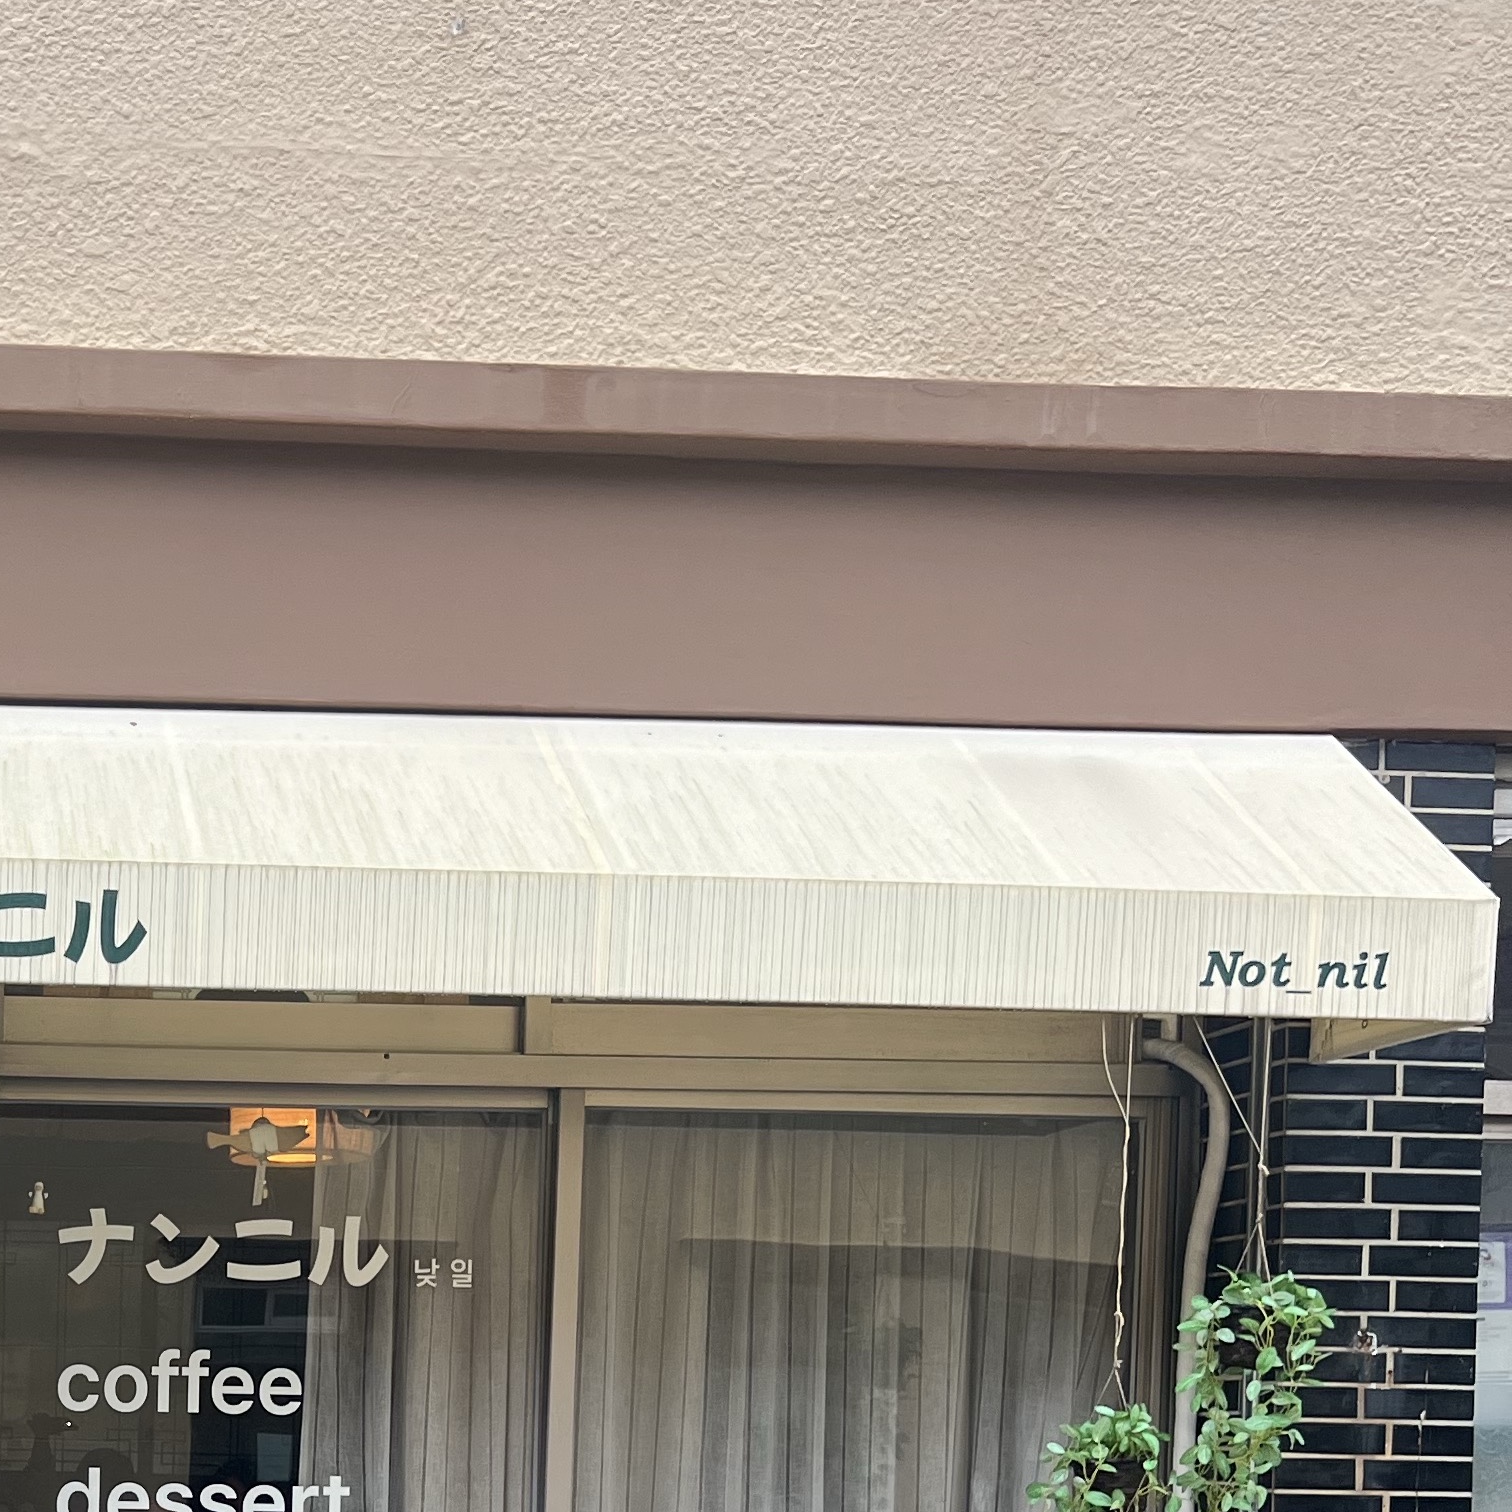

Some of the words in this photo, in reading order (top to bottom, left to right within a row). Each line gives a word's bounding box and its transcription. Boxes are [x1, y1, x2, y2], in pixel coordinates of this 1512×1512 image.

[1199, 951, 1390, 994] Not_nil
[58, 1208, 389, 1287] ナンニル
[57, 1349, 302, 1416] coffee
